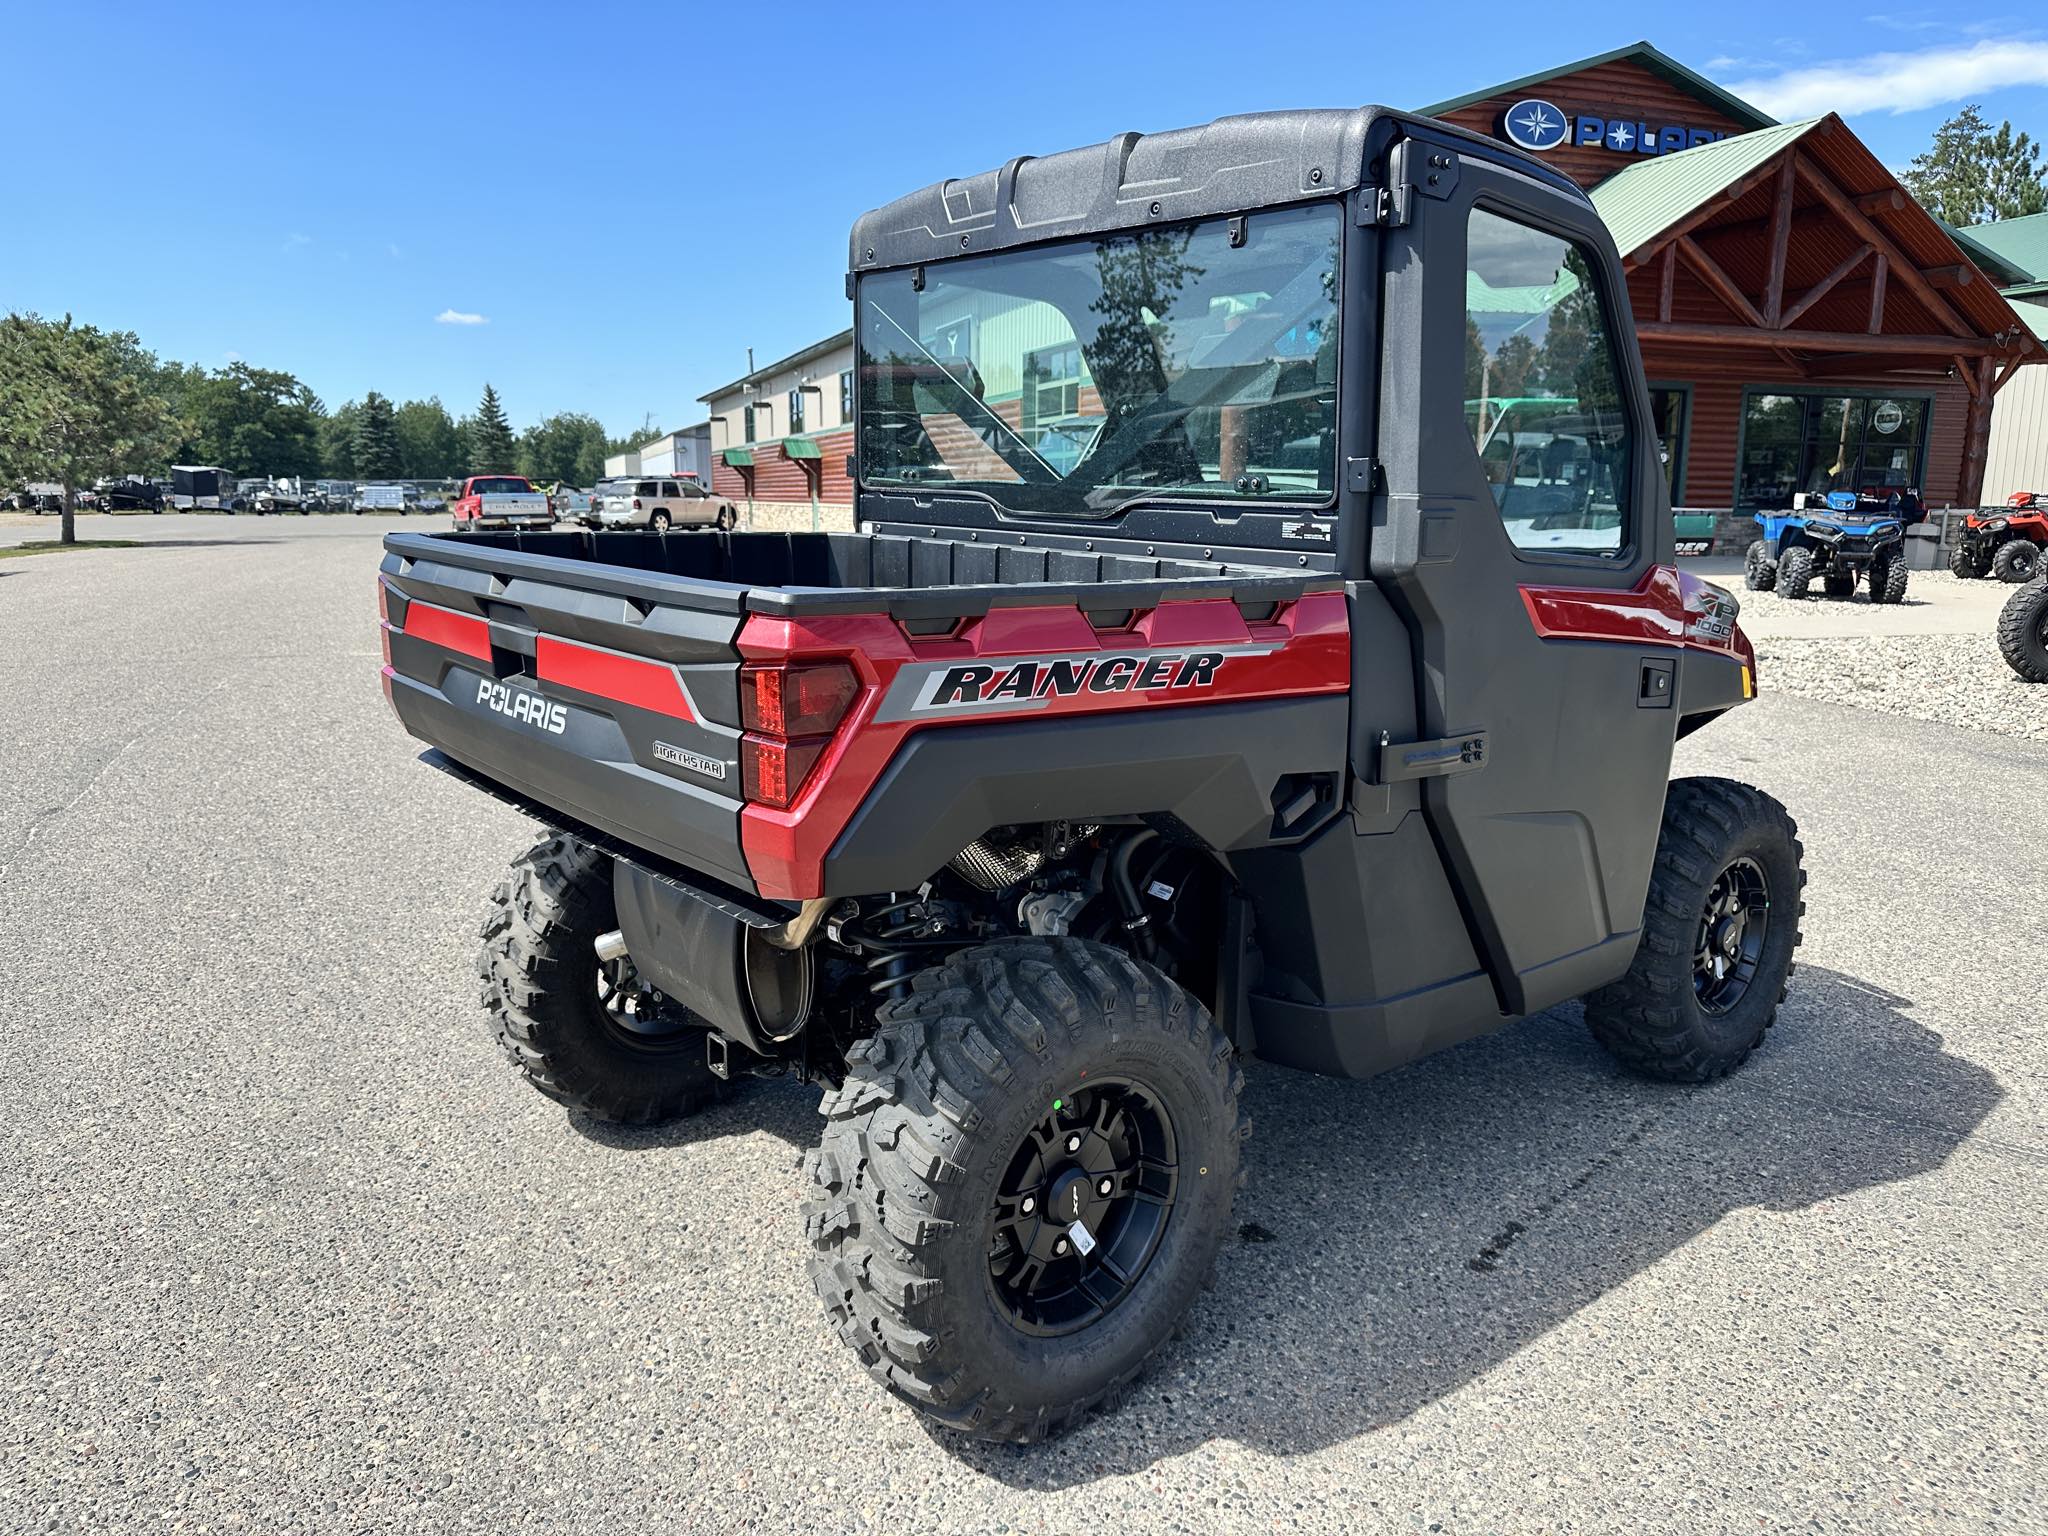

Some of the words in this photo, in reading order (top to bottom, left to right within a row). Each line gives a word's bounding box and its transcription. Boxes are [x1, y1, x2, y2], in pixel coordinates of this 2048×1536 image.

[1696, 618, 1733, 637] 1000
[929, 652, 1225, 706] RANGER
[476, 678, 568, 735] POLARIS
[654, 744, 720, 776] NORTHSTAR
